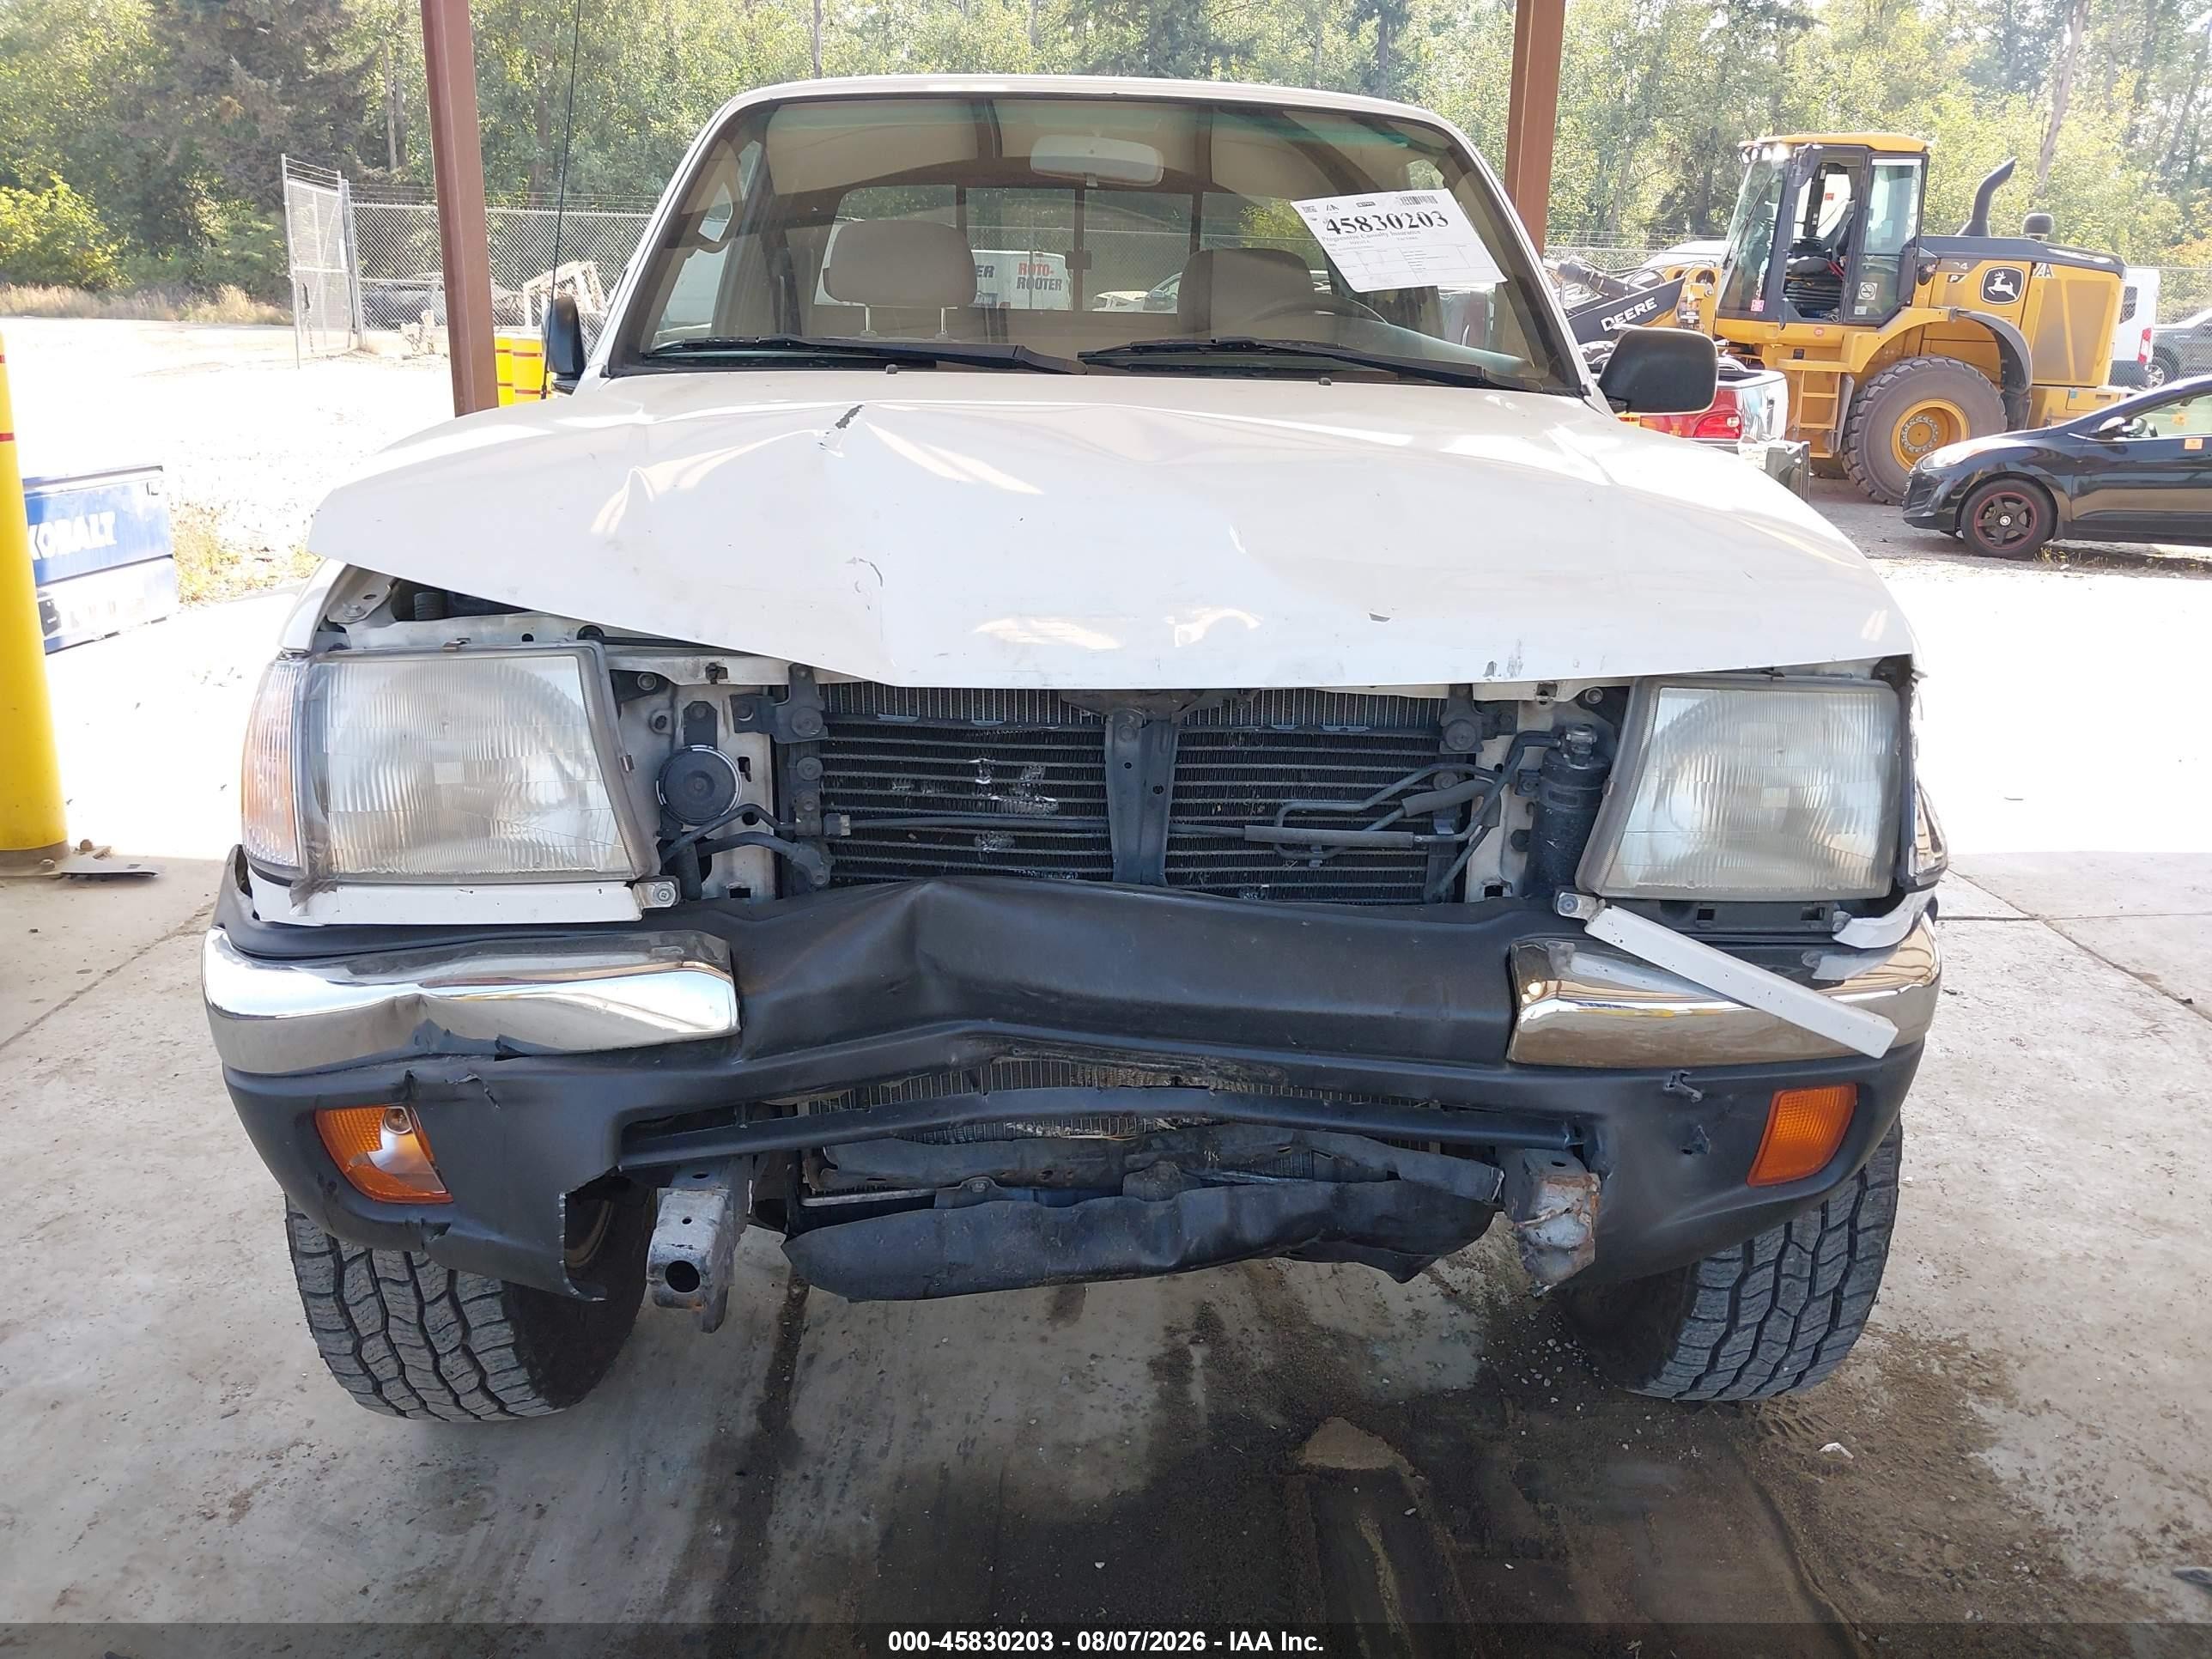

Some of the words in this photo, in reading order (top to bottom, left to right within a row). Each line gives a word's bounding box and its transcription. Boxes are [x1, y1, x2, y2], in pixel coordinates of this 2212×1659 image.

[1327, 211, 1449, 234] 45830203
[1018, 262, 1054, 276] ROTO-
[1017, 276, 1063, 291] ROOTER
[1601, 297, 1658, 331] DEERE
